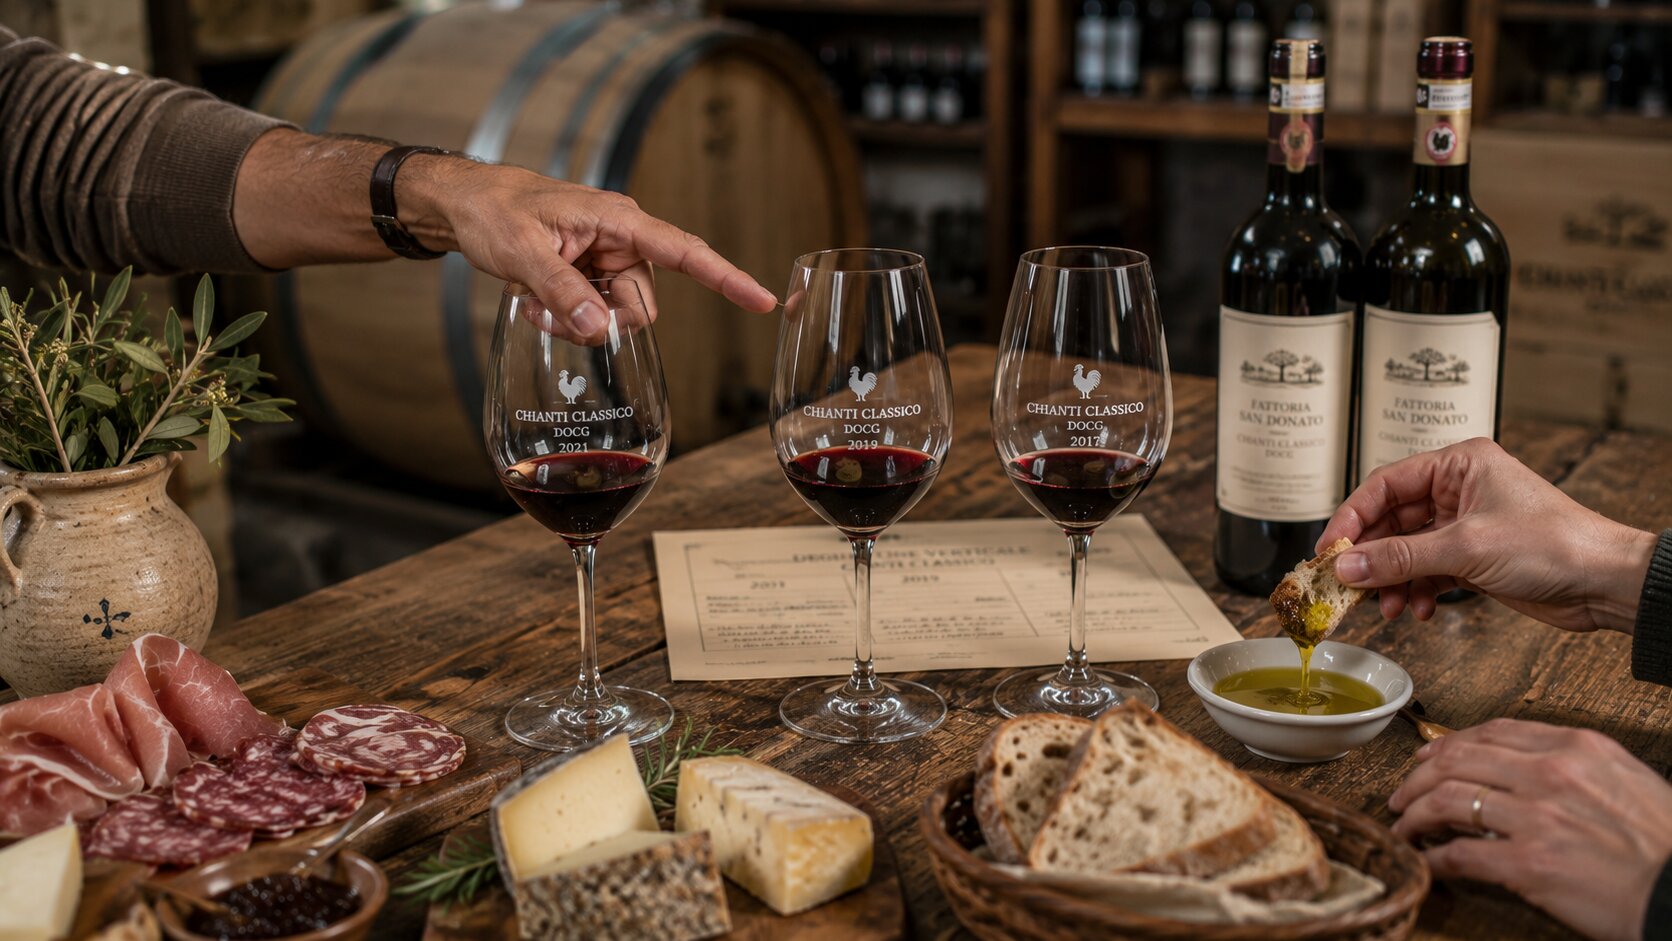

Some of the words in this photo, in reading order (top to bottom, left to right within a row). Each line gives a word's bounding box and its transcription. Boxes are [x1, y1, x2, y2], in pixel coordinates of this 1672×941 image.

[1026, 402, 1081, 417] CHIANTI
[1085, 401, 1144, 417] CLASSICO
[1250, 399, 1312, 412] FATTORIA
[1394, 398, 1455, 411] FATTORIA
[515, 409, 568, 423] CHIANTI
[572, 406, 634, 422] CLASSICO
[803, 405, 858, 419] CHIANTI
[861, 404, 921, 419] CLASSICO
[1381, 408, 1406, 422] SAN
[1410, 413, 1469, 425] DONATO
[1238, 410, 1263, 425] SAN
[1266, 415, 1325, 427] DONATO
[553, 427, 590, 438] DOCG
[844, 424, 880, 434] DOCG
[1067, 421, 1104, 431] DOCG
[559, 443, 588, 453] 2021
[847, 440, 878, 450] 2019
[1070, 436, 1100, 447] 2017
